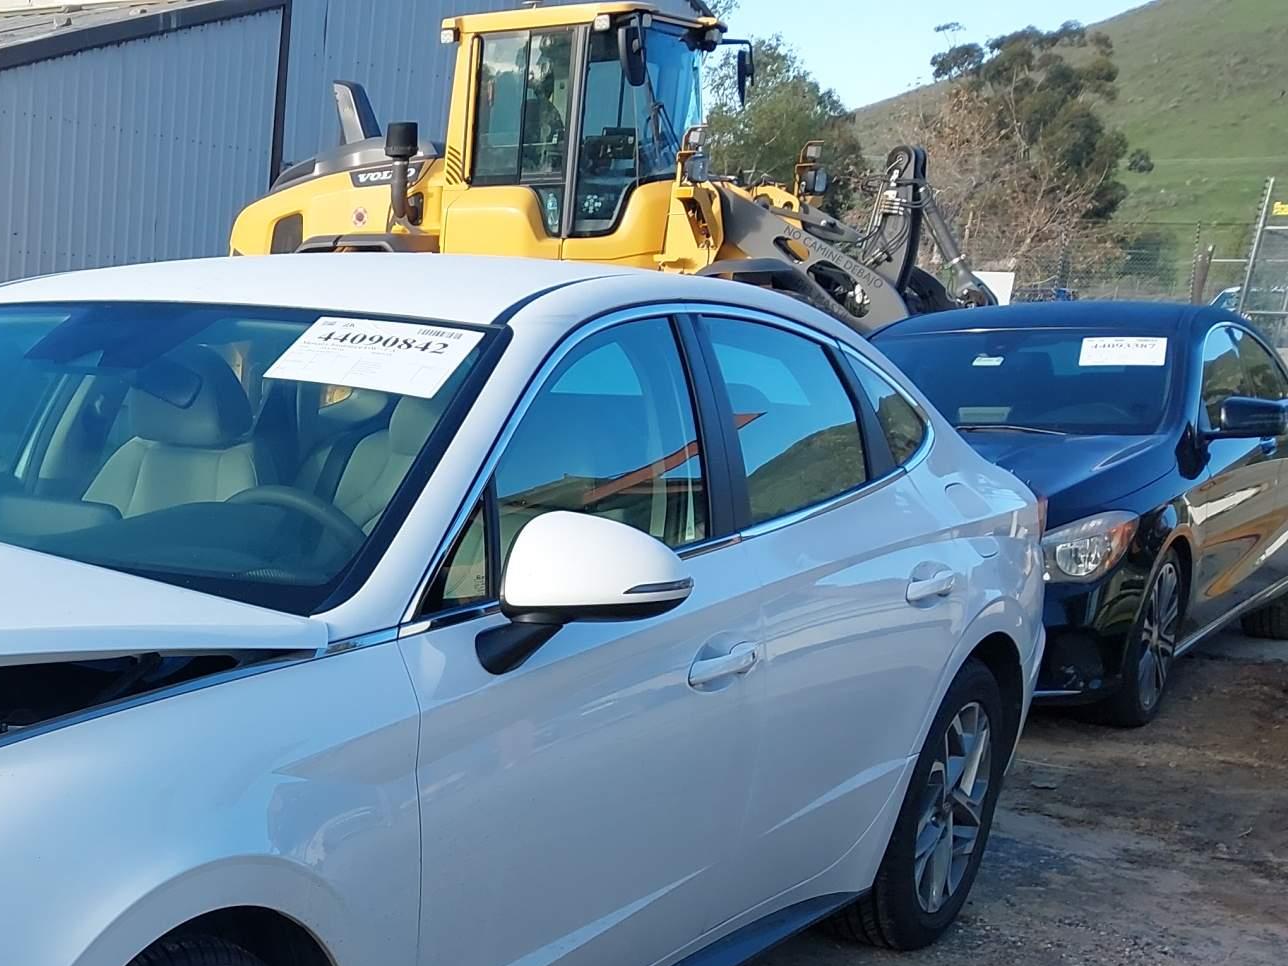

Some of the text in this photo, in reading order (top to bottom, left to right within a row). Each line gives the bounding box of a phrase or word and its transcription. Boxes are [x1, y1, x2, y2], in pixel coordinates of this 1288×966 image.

[358, 167, 416, 183] VOLO
[783, 225, 883, 289] NO CAMINE DEBAJO
[317, 331, 449, 355] 44090842
